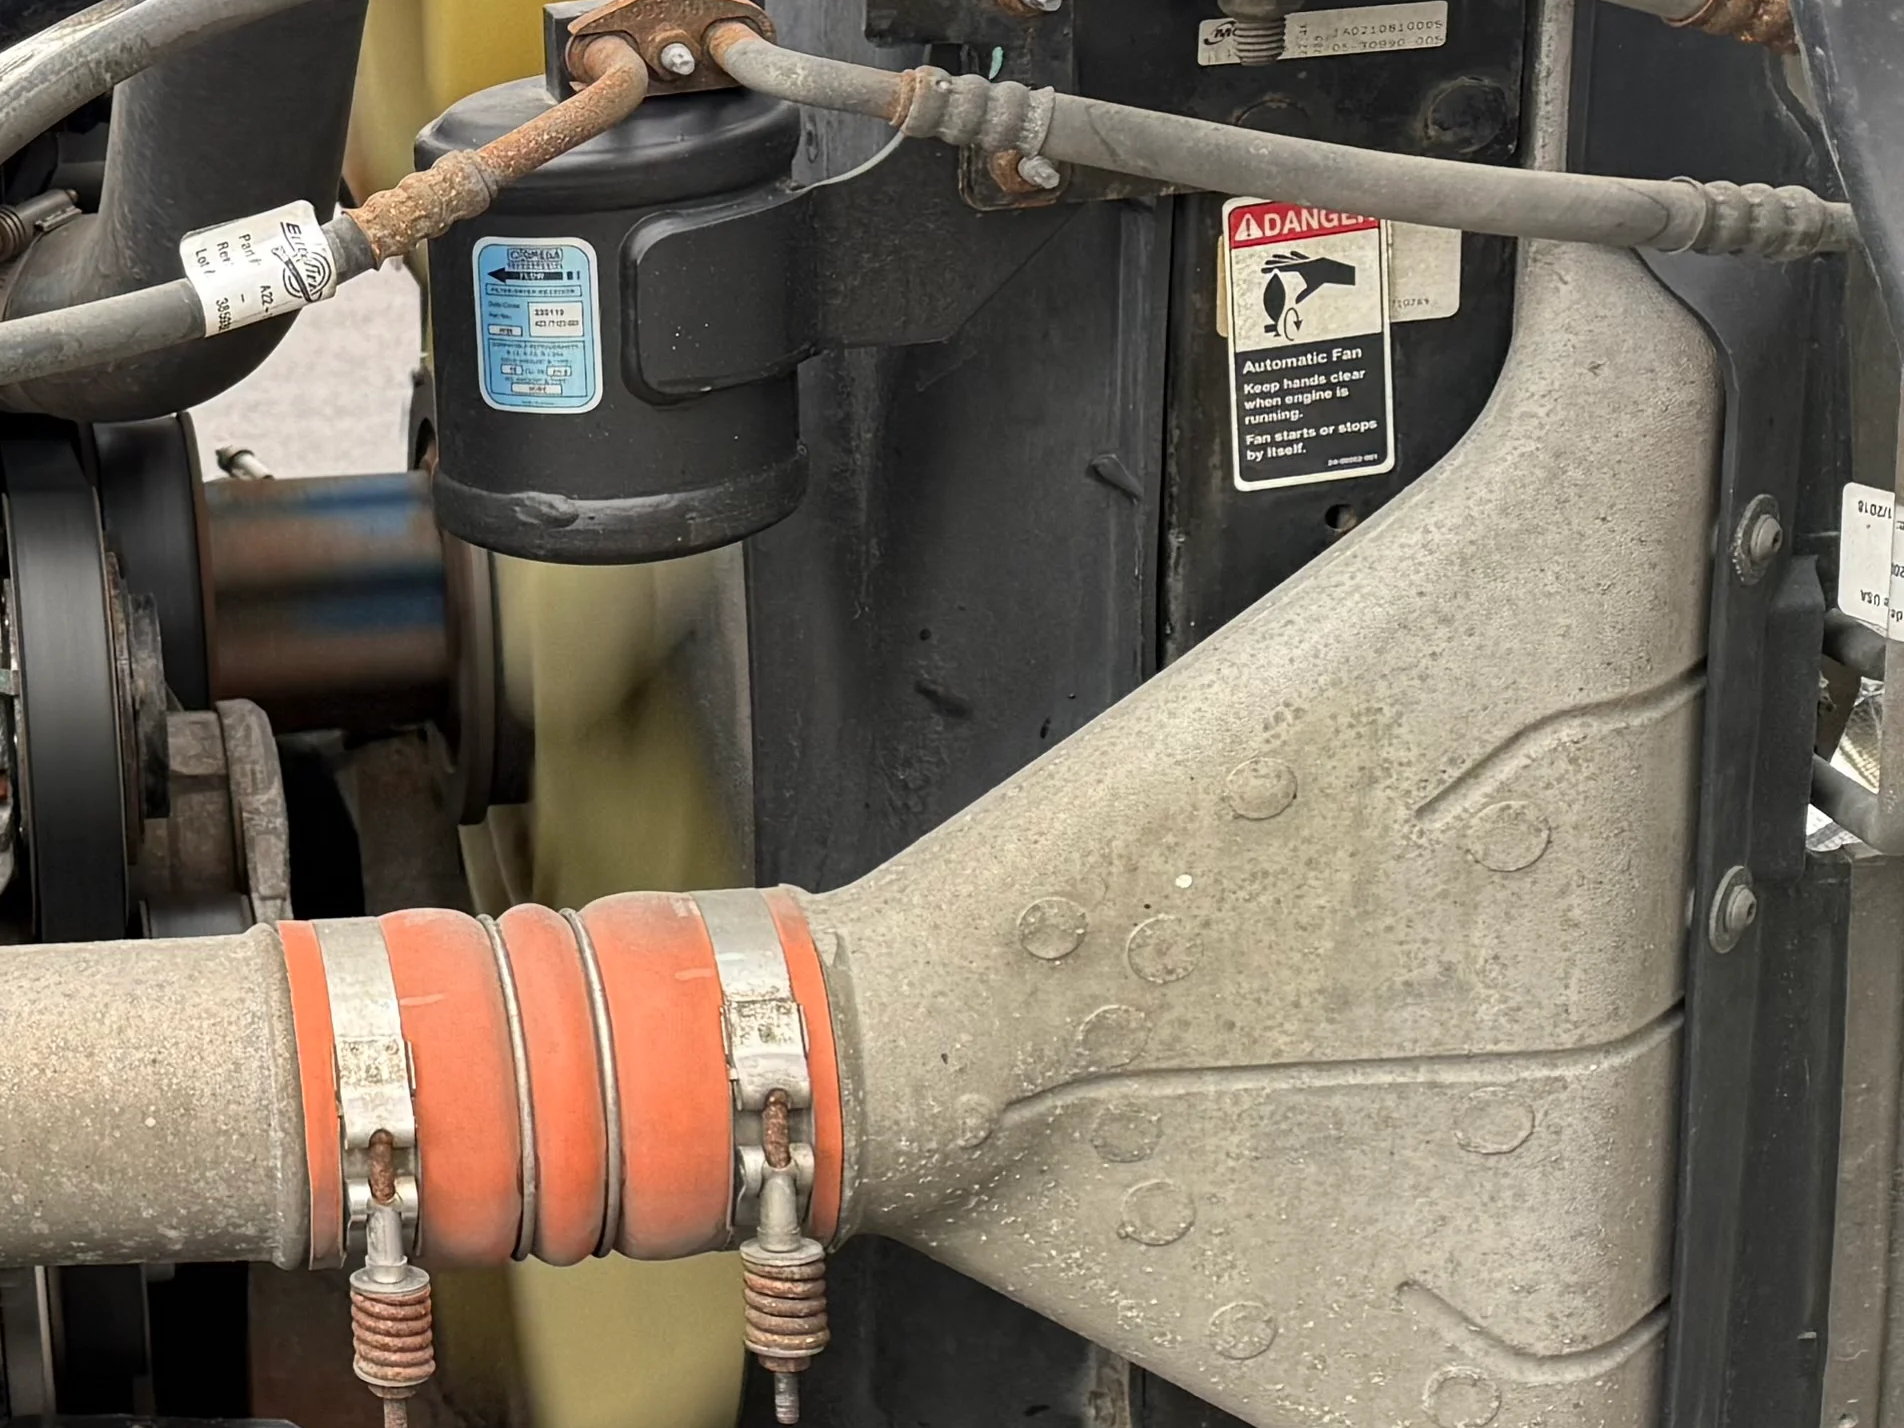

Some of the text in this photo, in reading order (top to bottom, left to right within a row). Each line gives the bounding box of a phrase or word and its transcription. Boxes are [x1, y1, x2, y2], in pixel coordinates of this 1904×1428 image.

[1263, 209, 1375, 237] DANGE
[1242, 346, 1362, 374] Automatic Fan
[1243, 368, 1366, 397] Keep hands clear
[1244, 386, 1349, 410] when engine is
[1245, 410, 1303, 425] running.
[1246, 419, 1378, 446] Fan starts or stops
[1246, 448, 1263, 462] by
